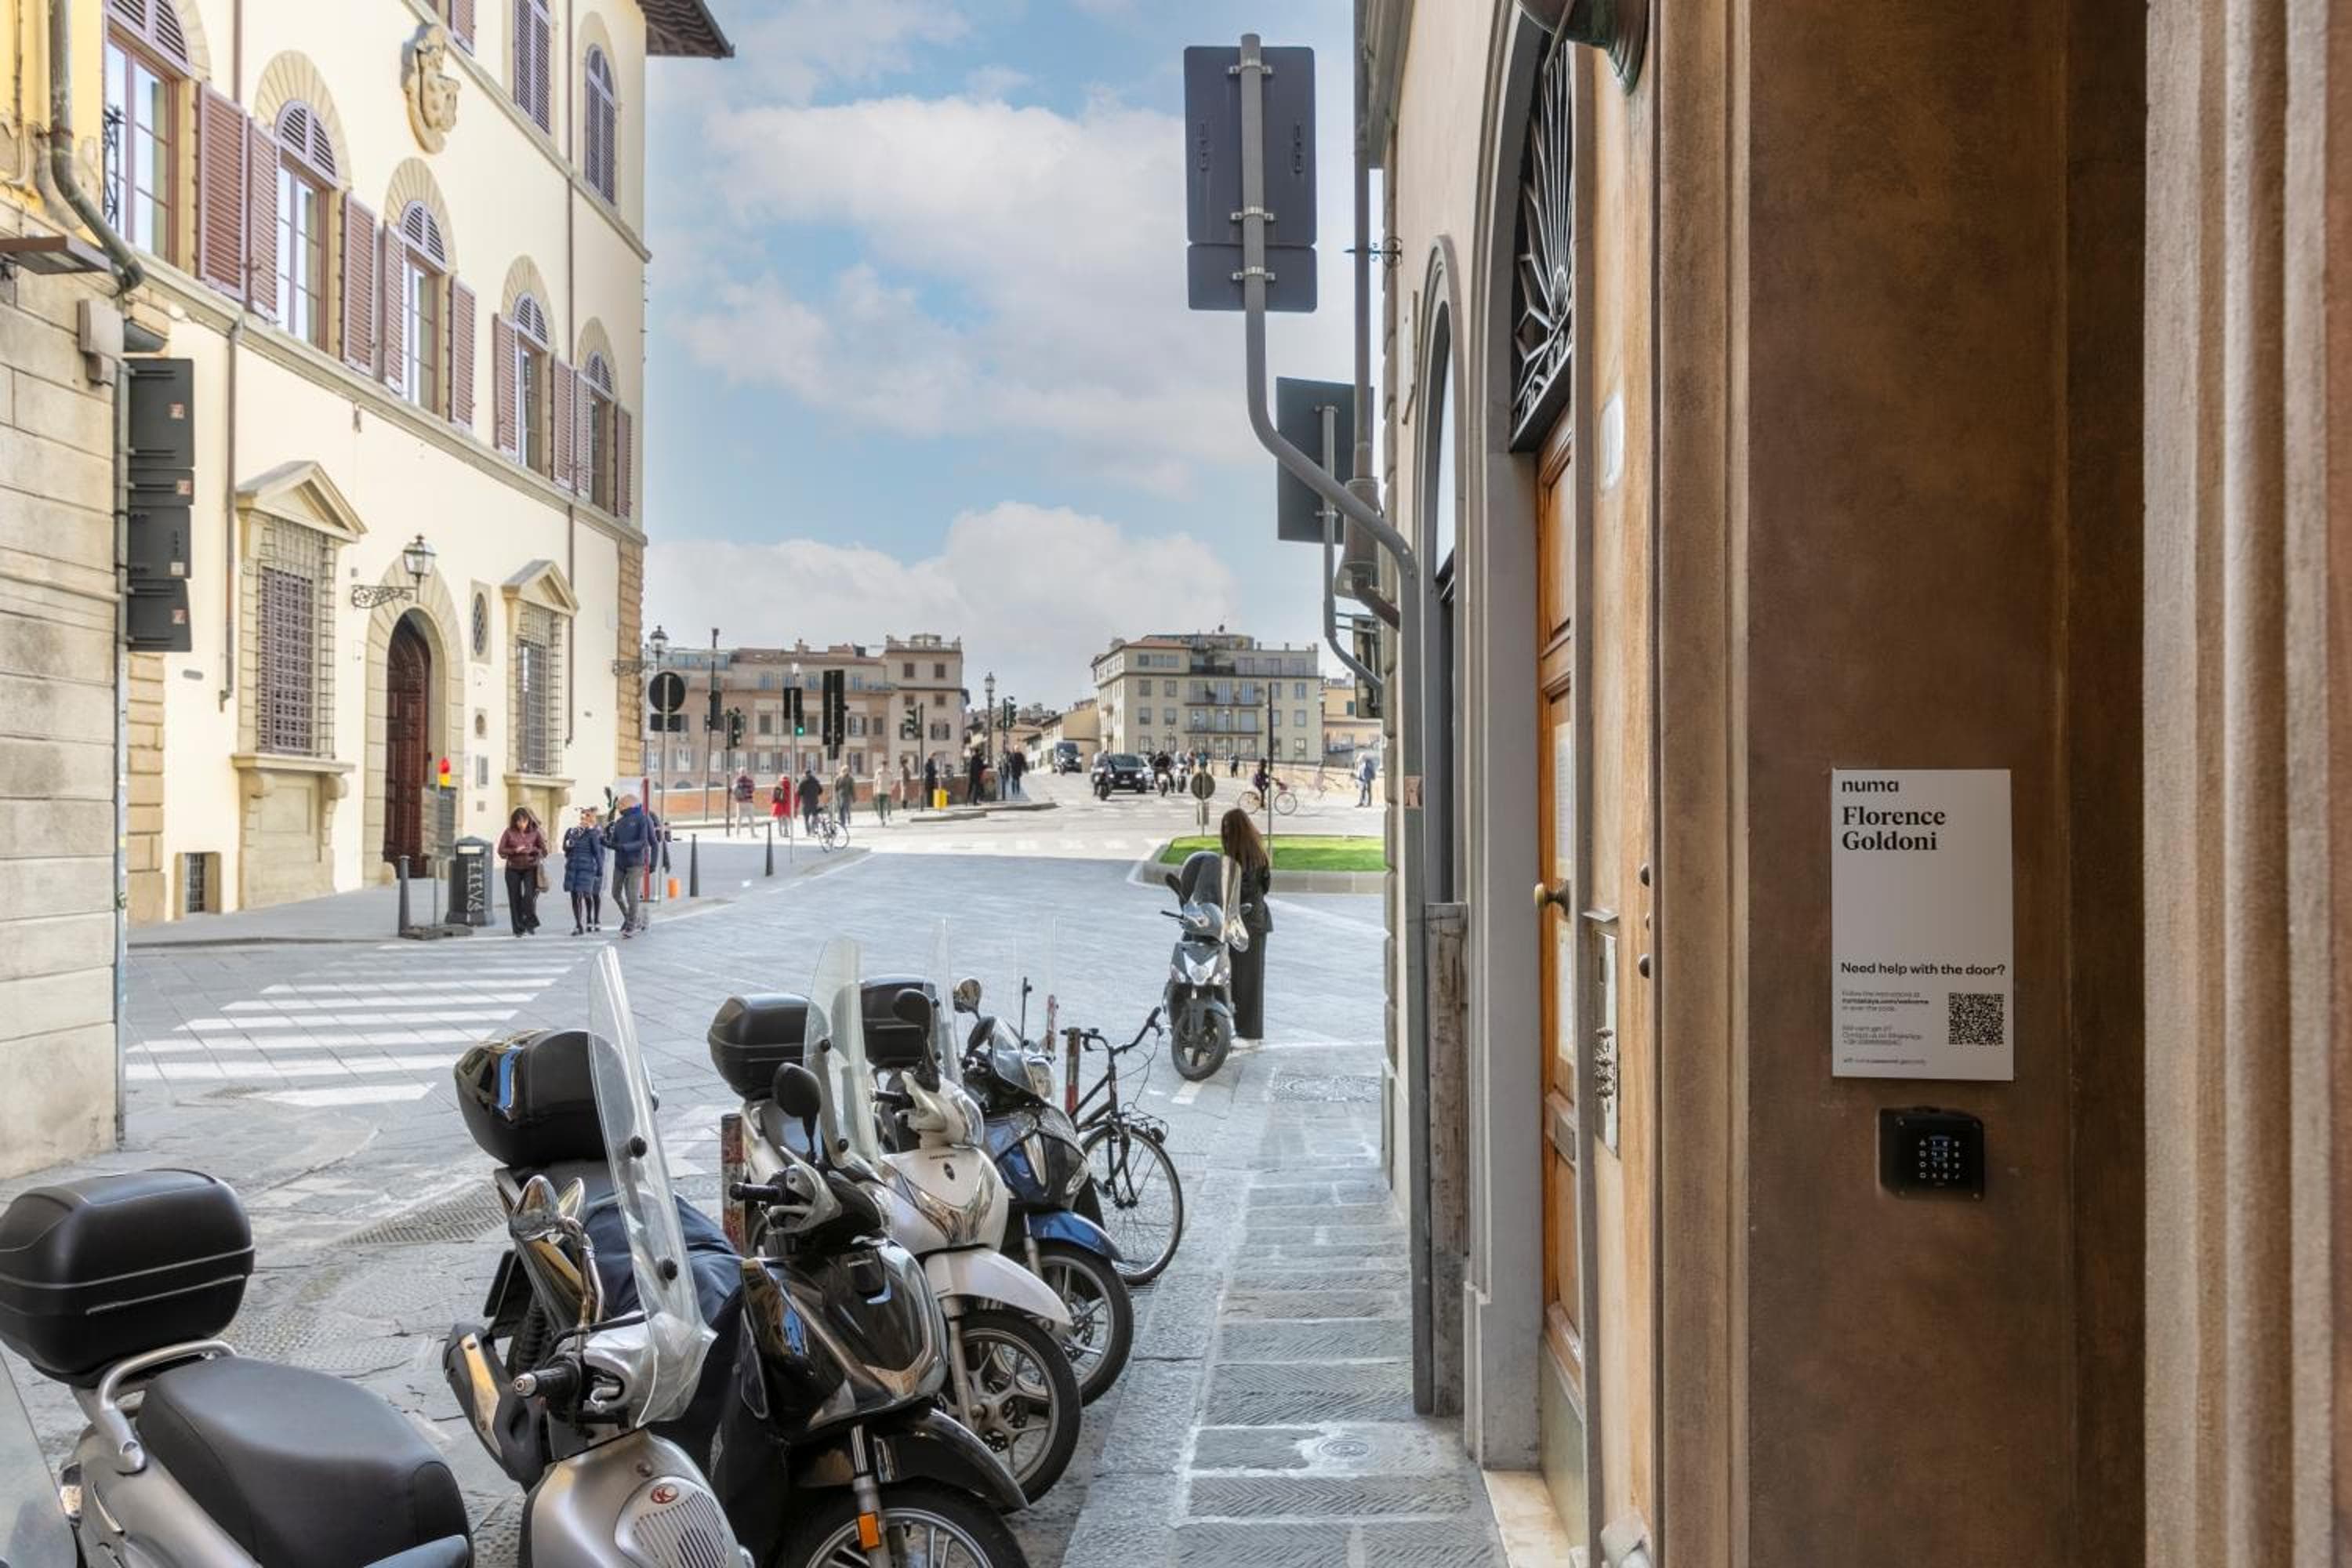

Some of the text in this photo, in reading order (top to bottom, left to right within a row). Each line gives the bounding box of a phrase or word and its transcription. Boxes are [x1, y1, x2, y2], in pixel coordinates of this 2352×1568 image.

[1842, 780, 1899, 793] numa
[1843, 806, 1946, 826] Florence
[1842, 830, 1937, 851] Goldoni
[1841, 962, 2005, 975] Need help with the door?
